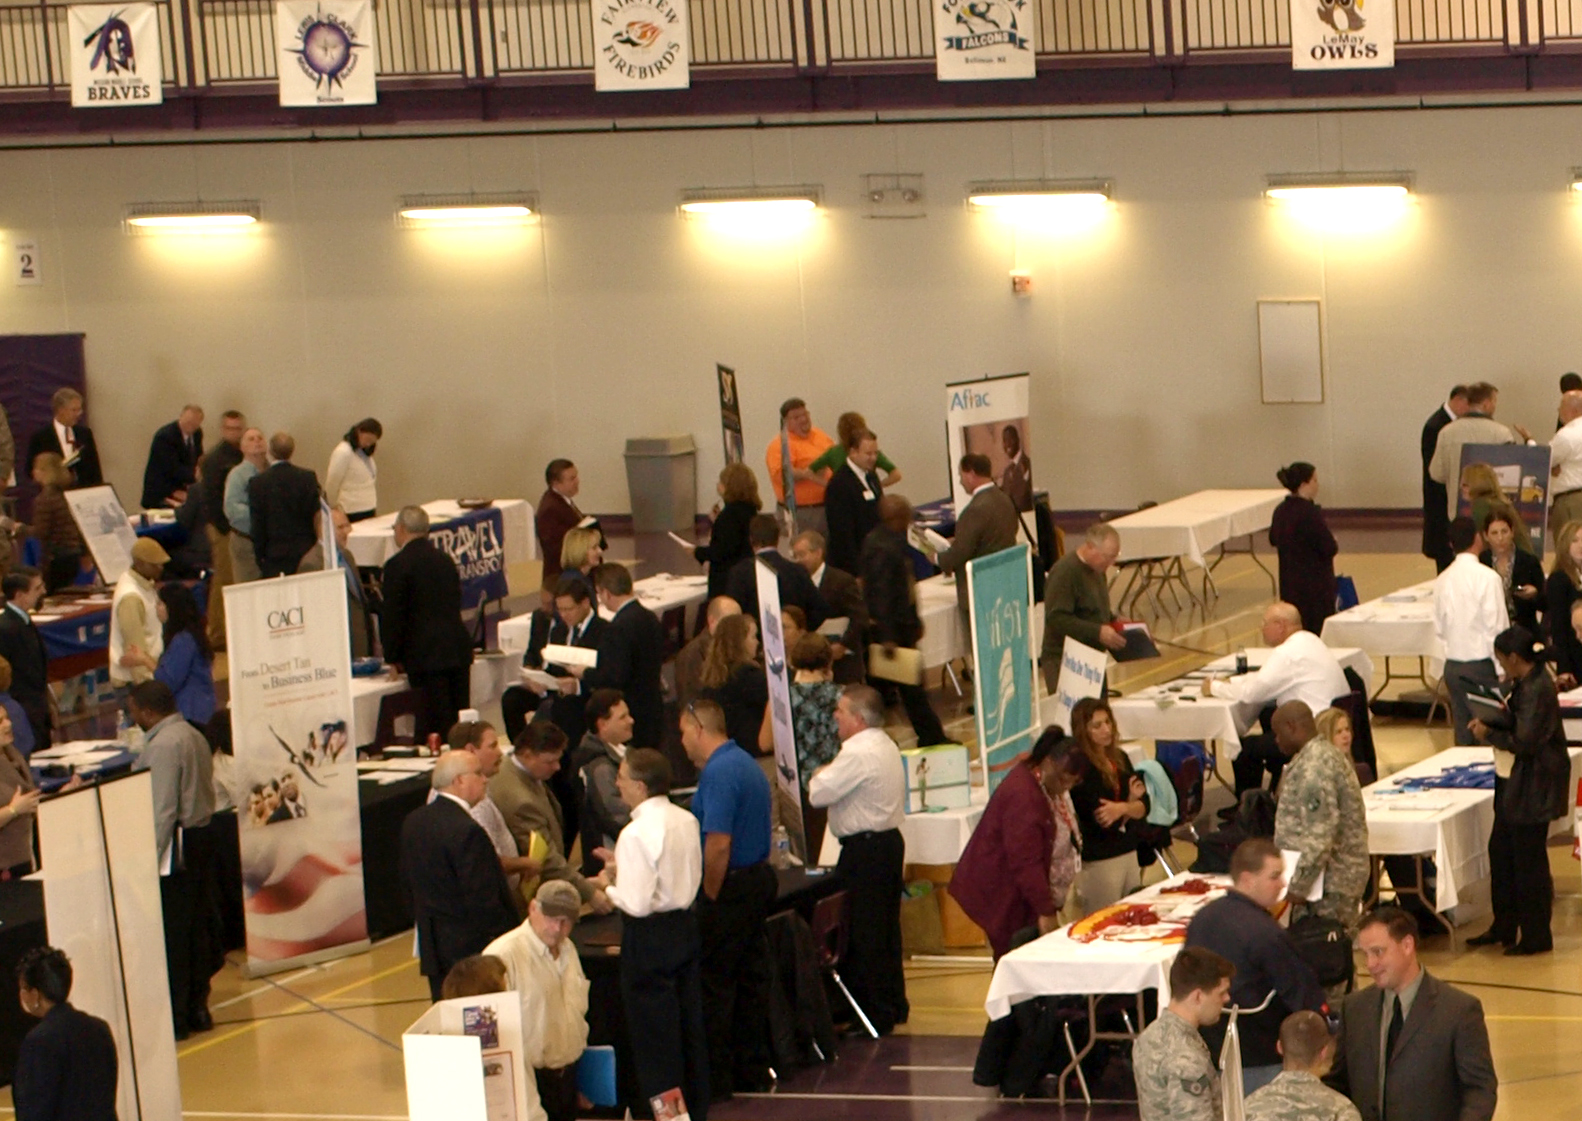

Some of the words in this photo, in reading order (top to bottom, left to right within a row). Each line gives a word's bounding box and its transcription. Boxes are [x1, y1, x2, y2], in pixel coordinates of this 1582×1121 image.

[601, 0, 679, 26] FAIEW
[961, 32, 1009, 49] FALCONS
[1322, 34, 1365, 45] LeMay
[602, 41, 680, 80] FIREBIRDS
[1310, 43, 1378, 61] OWLS
[88, 85, 150, 101] BRAVES
[20, 253, 34, 275] 2
[267, 606, 304, 629] CACI
[260, 661, 291, 676] Desert
[294, 657, 311, 669] Tan
[270, 673, 313, 689] Business
[314, 668, 337, 681] Blue
